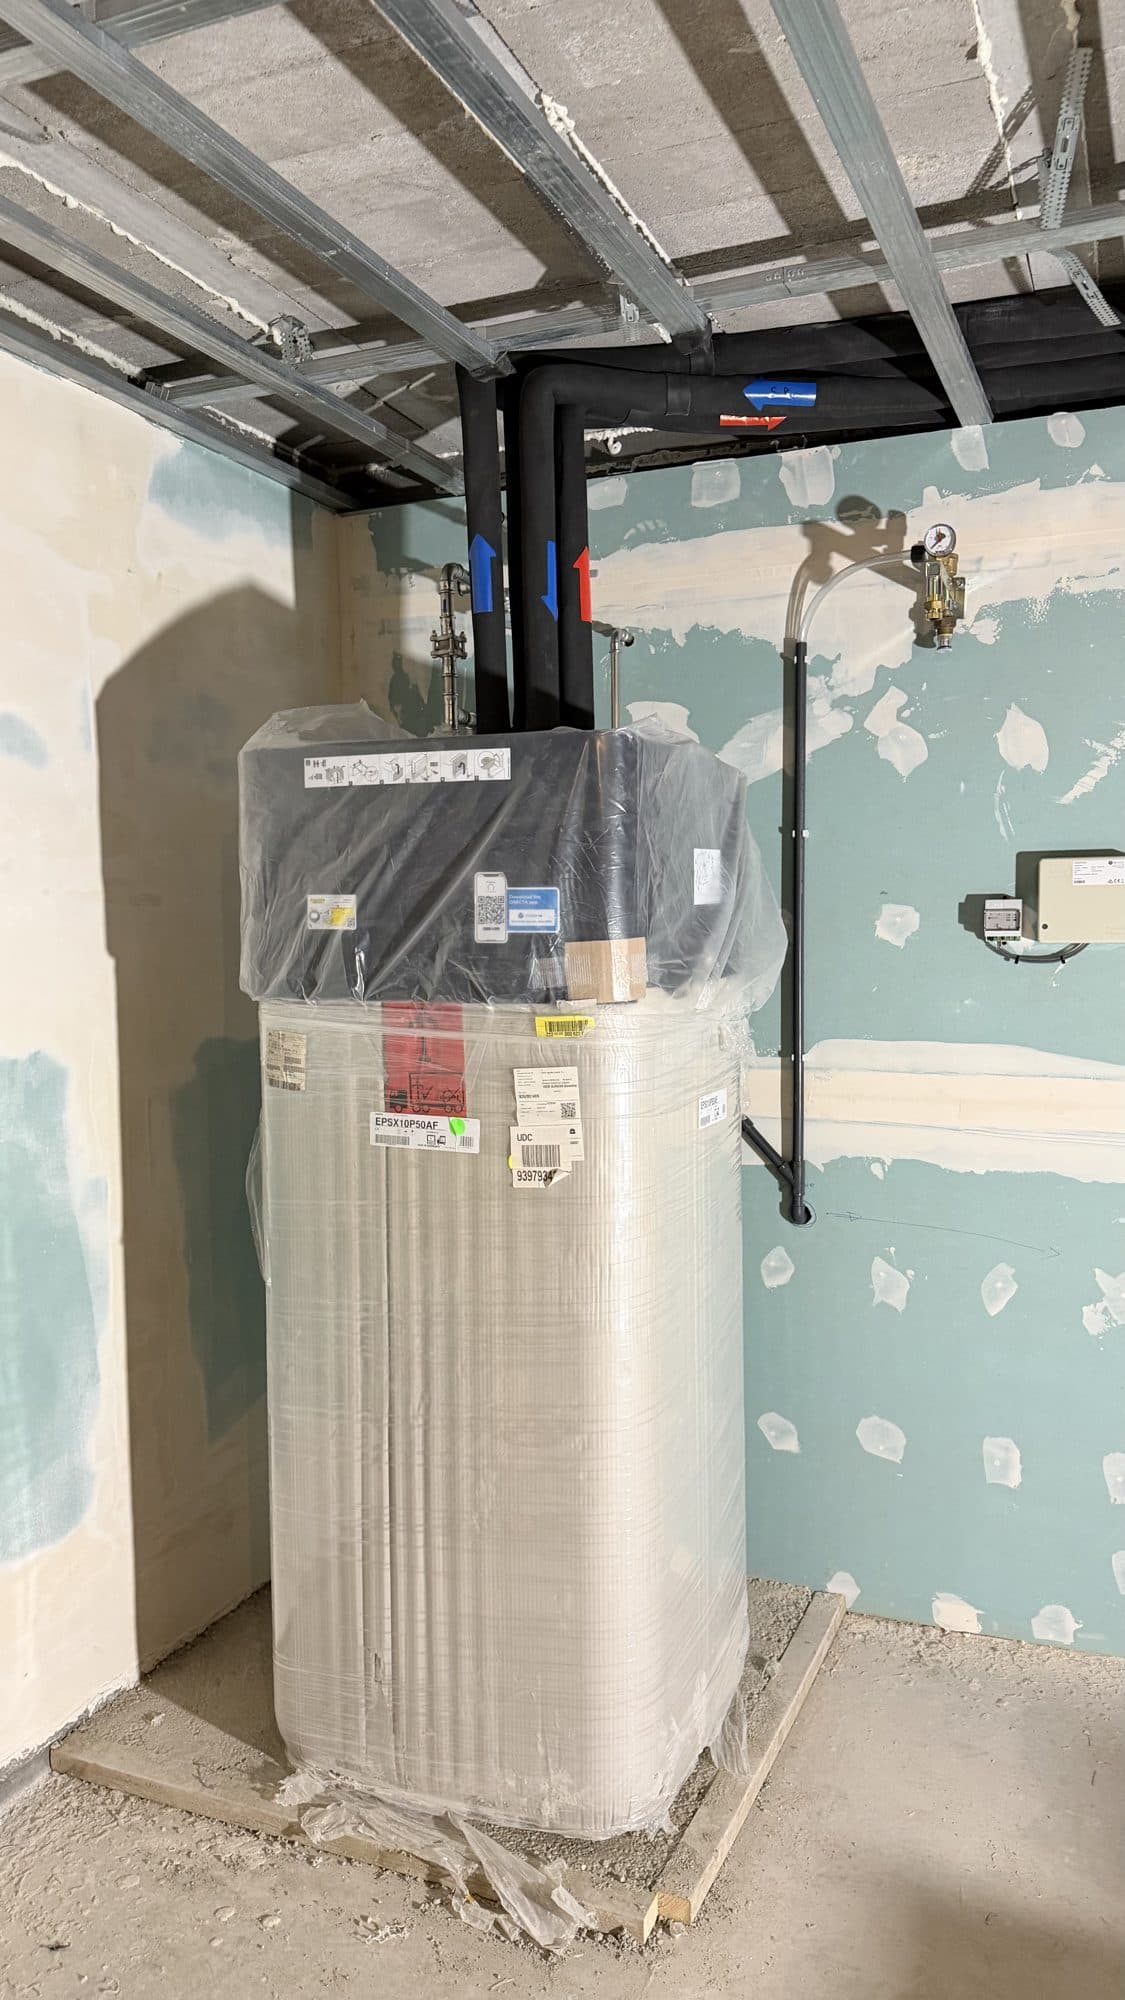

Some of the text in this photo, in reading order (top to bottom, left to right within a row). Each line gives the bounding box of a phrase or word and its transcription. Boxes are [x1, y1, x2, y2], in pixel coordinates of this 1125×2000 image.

[375, 1117, 439, 1130] EPSX10P50AF
[516, 1133, 533, 1142] UDC
[516, 1168, 557, 1182] 9397934
